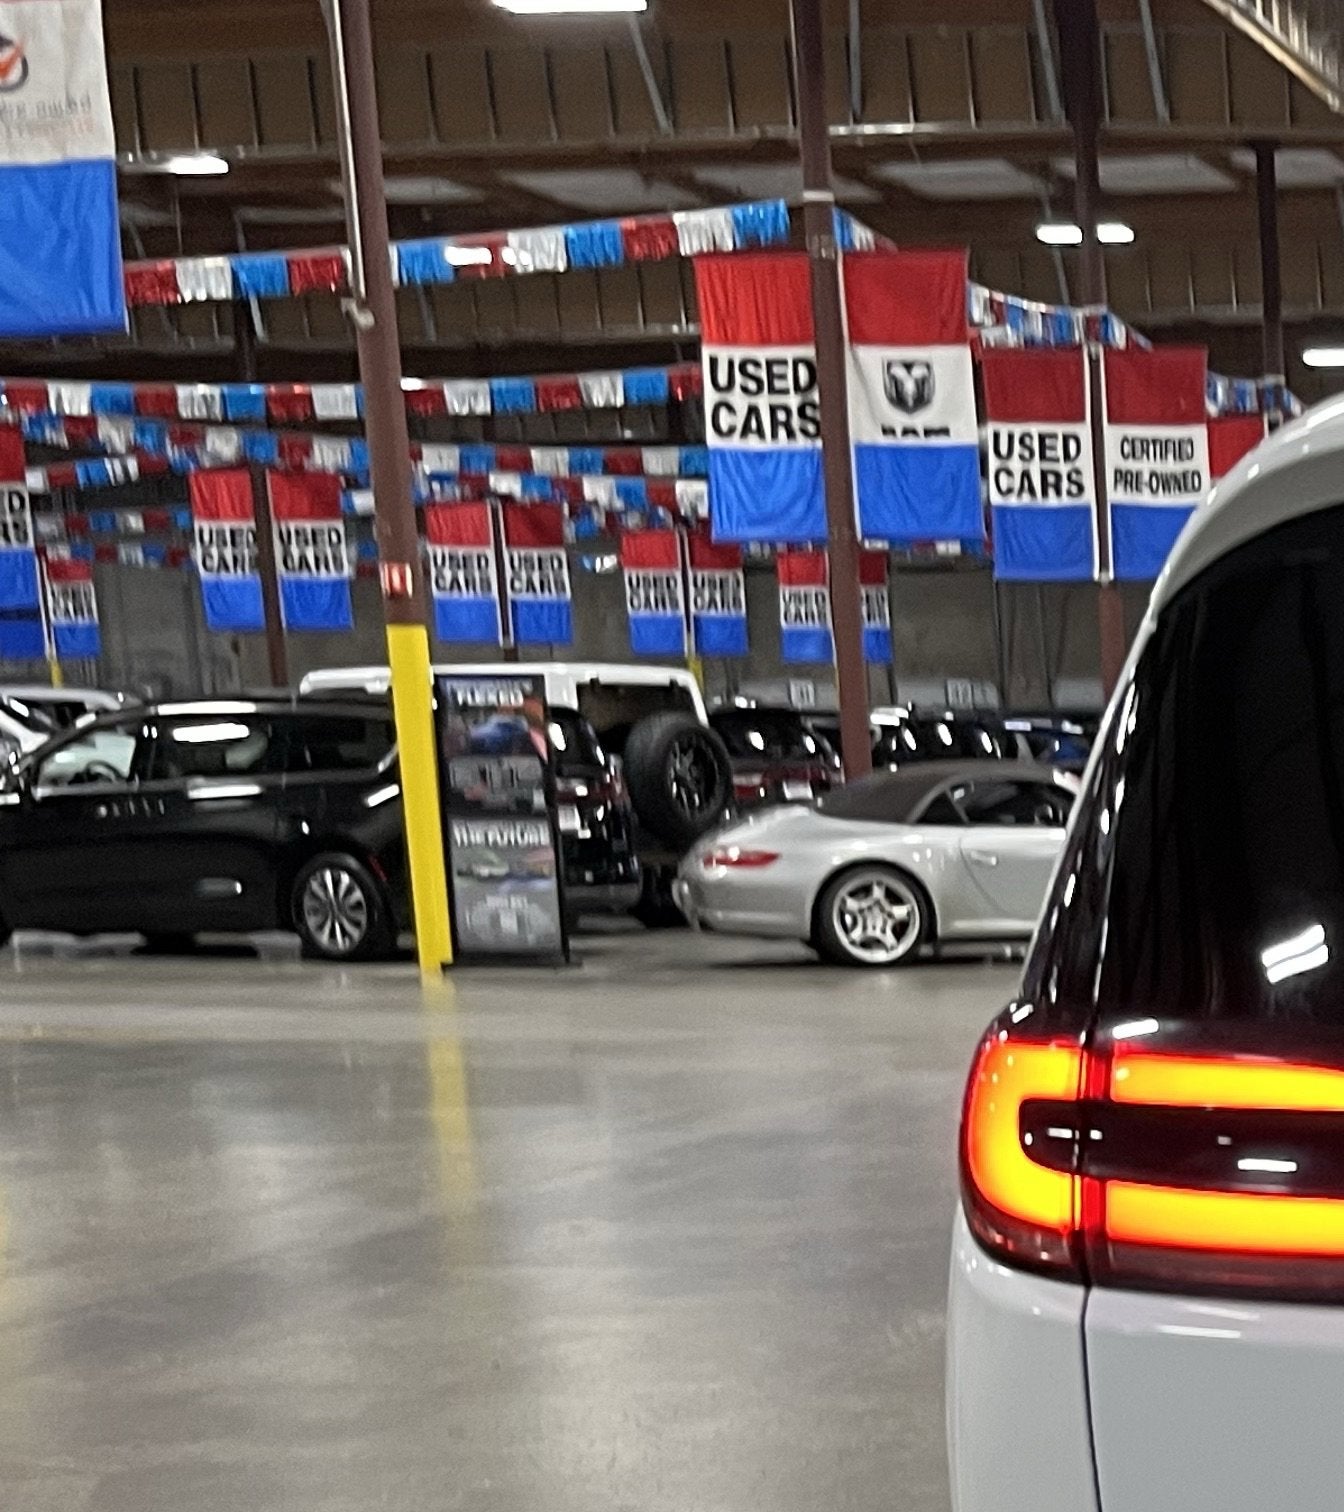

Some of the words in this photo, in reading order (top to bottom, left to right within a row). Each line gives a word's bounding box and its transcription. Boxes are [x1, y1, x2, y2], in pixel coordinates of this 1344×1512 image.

[709, 355, 817, 396] USED
[711, 401, 821, 441] CARS
[993, 430, 1082, 463] USED
[1120, 436, 1194, 461] CERTIFIED
[994, 467, 1085, 498] CARS
[1114, 467, 1202, 494] PRE-OWNED
[199, 527, 257, 548] USED
[279, 527, 341, 548] USED
[282, 551, 344, 573] CARS
[432, 552, 489, 571] USED
[508, 553, 562, 572] USED
[434, 573, 493, 593] CARS
[510, 574, 566, 593] CARS
